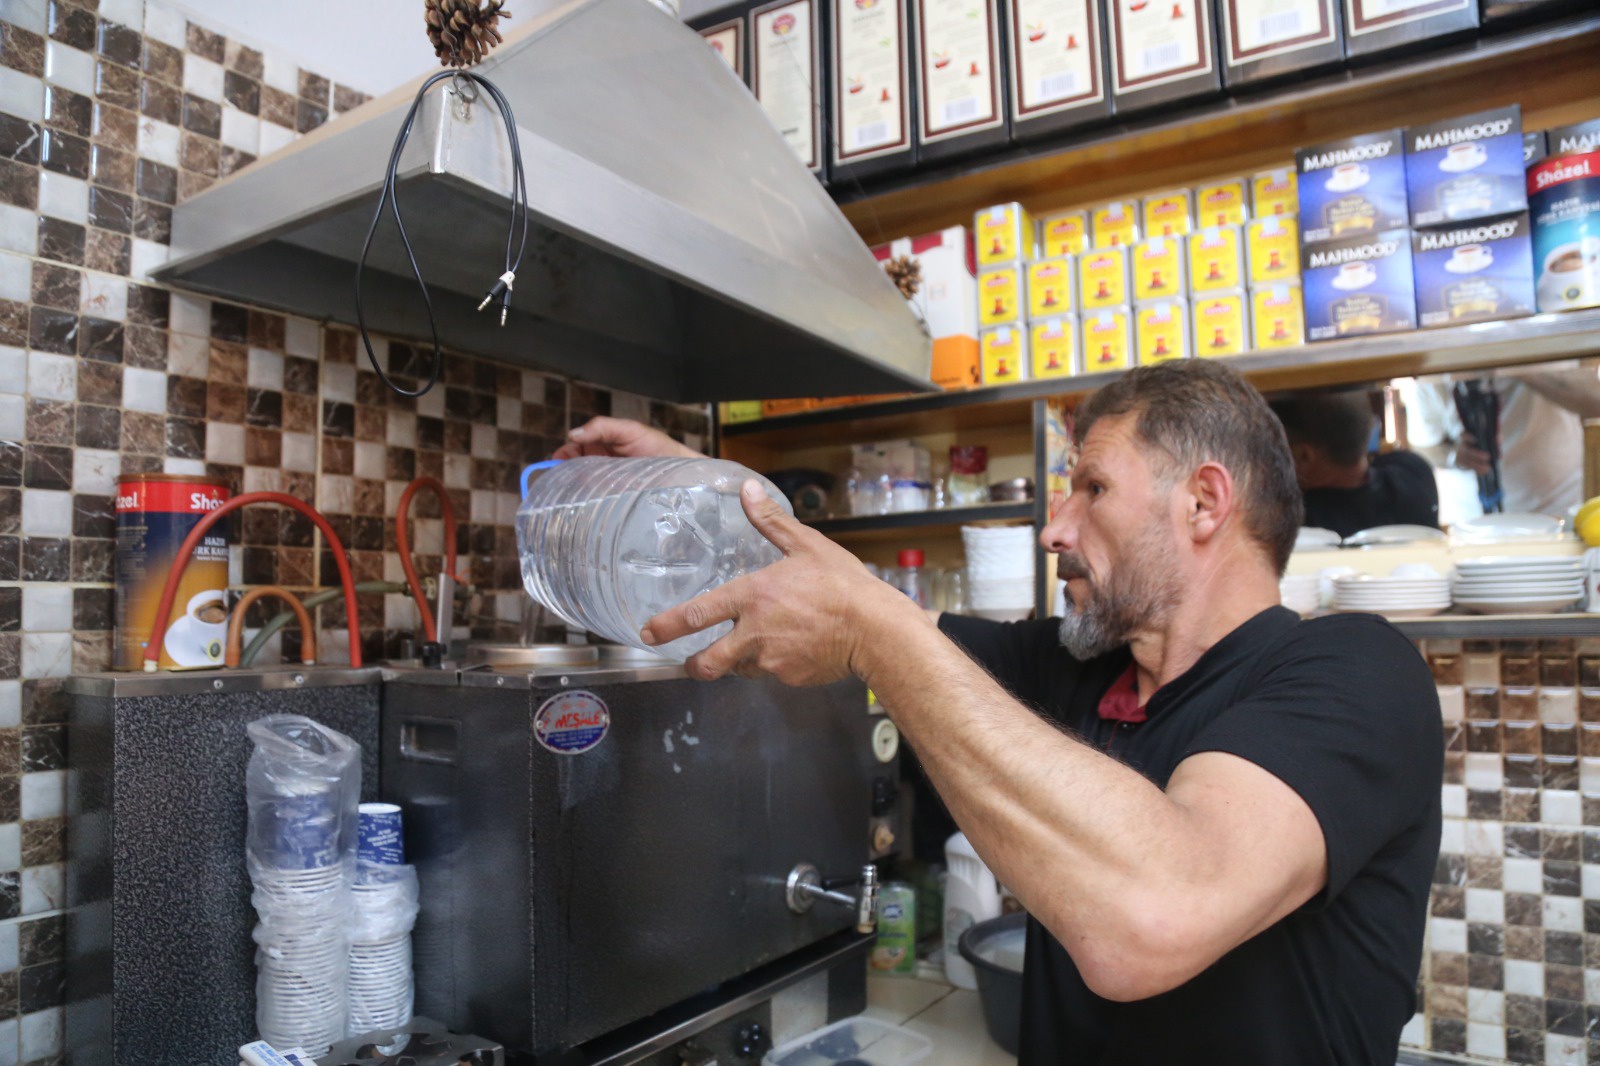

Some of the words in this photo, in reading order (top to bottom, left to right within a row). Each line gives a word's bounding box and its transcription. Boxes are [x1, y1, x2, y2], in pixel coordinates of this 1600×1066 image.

[1414, 119, 1512, 152] MAHMOOD
[1303, 141, 1391, 172] MAHMOOD
[1535, 158, 1591, 189] Shazel
[1420, 221, 1516, 252] MAHMOOD
[1309, 240, 1397, 269] MAHMOOD
